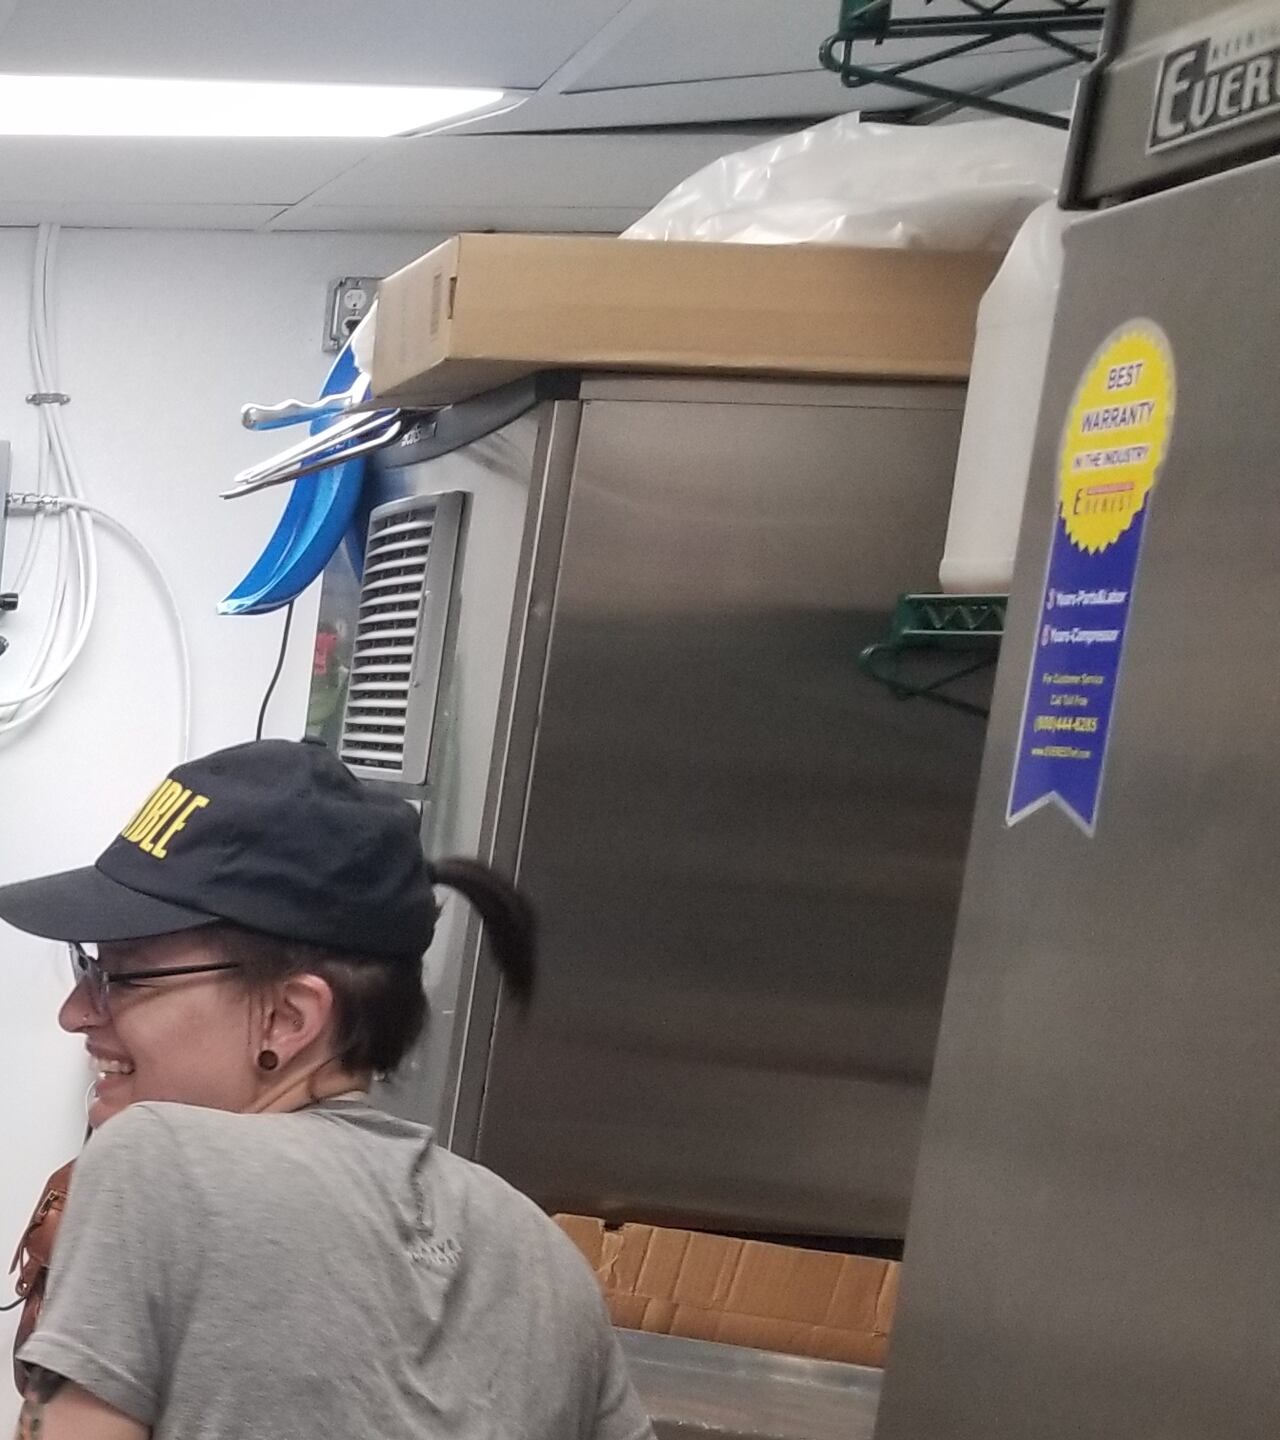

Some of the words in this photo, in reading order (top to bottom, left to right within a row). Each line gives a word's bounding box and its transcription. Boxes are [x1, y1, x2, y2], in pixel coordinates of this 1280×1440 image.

[1156, 49, 1280, 137] EVER
[1107, 363, 1143, 390] BEST
[1081, 401, 1155, 433] WARRANTY
[121, 778, 210, 860] BLE
